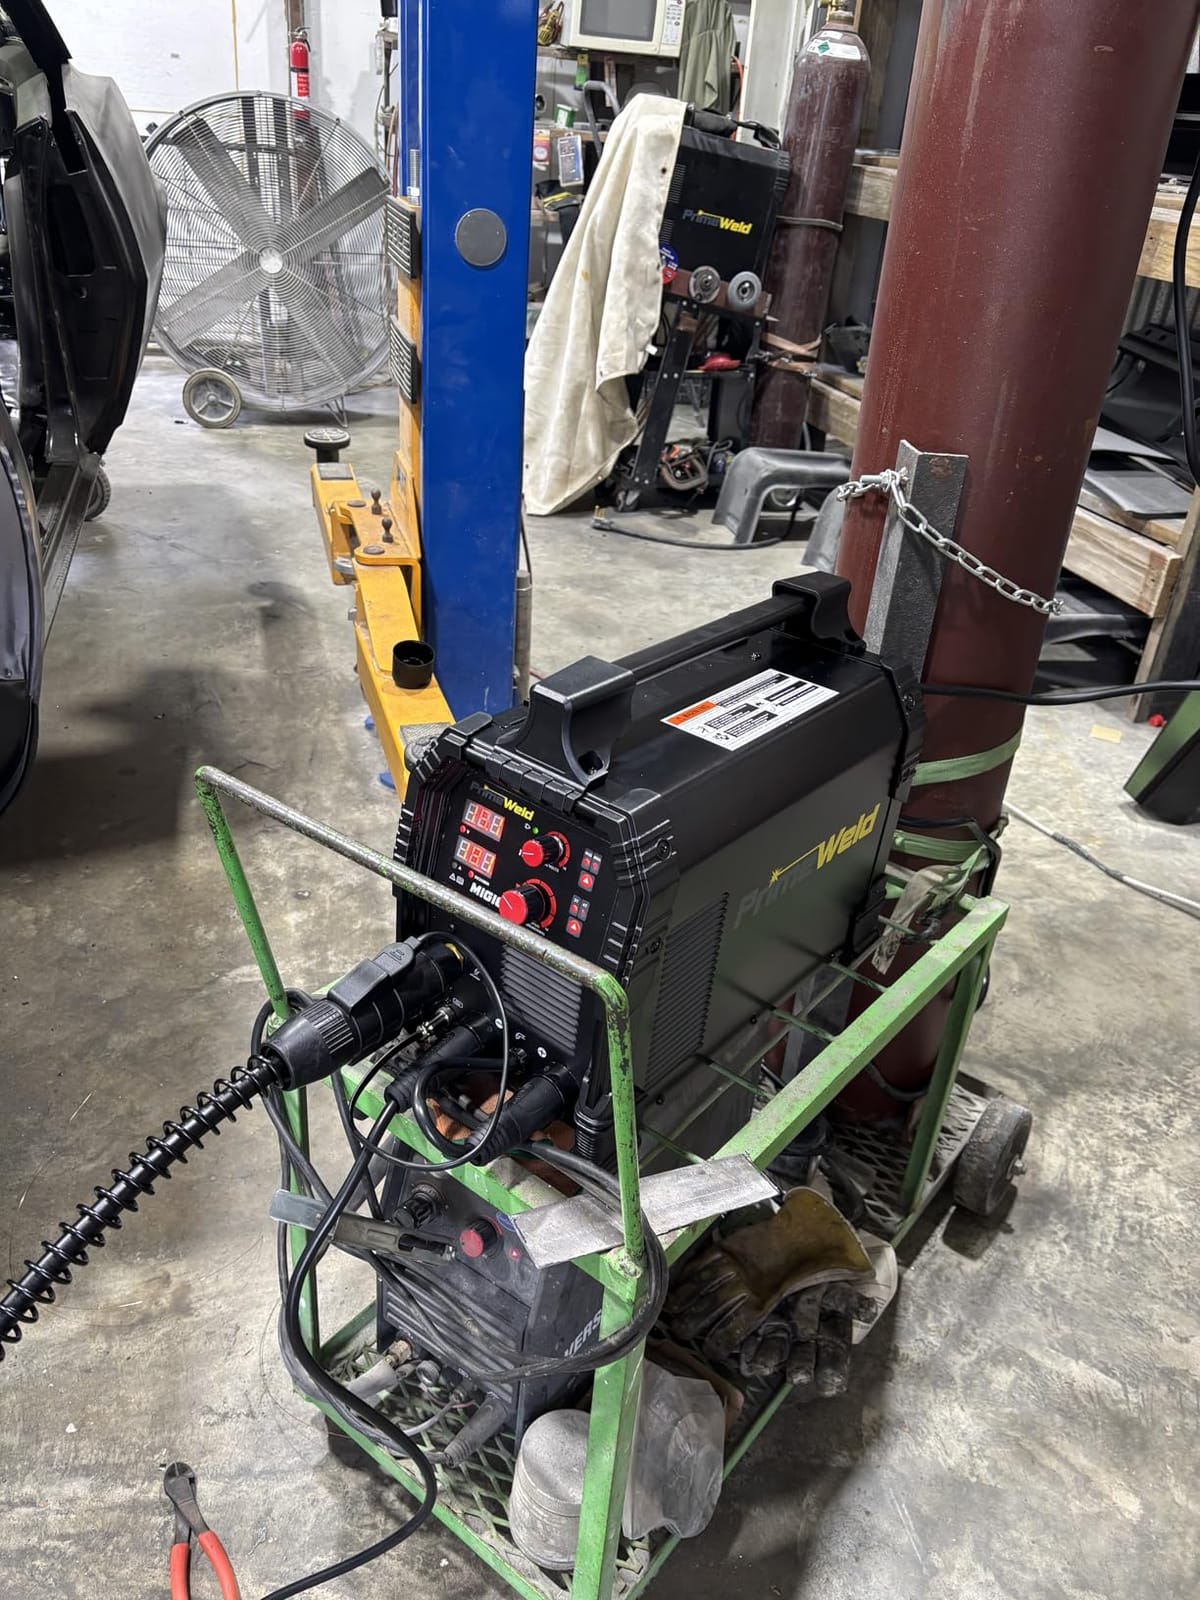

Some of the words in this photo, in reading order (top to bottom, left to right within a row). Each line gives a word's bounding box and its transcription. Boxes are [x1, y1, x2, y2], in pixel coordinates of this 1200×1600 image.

[682, 209, 752, 235] PrimeWeld
[471, 782, 534, 821] PrimeWeld
[733, 803, 881, 929] PrimeWeld
